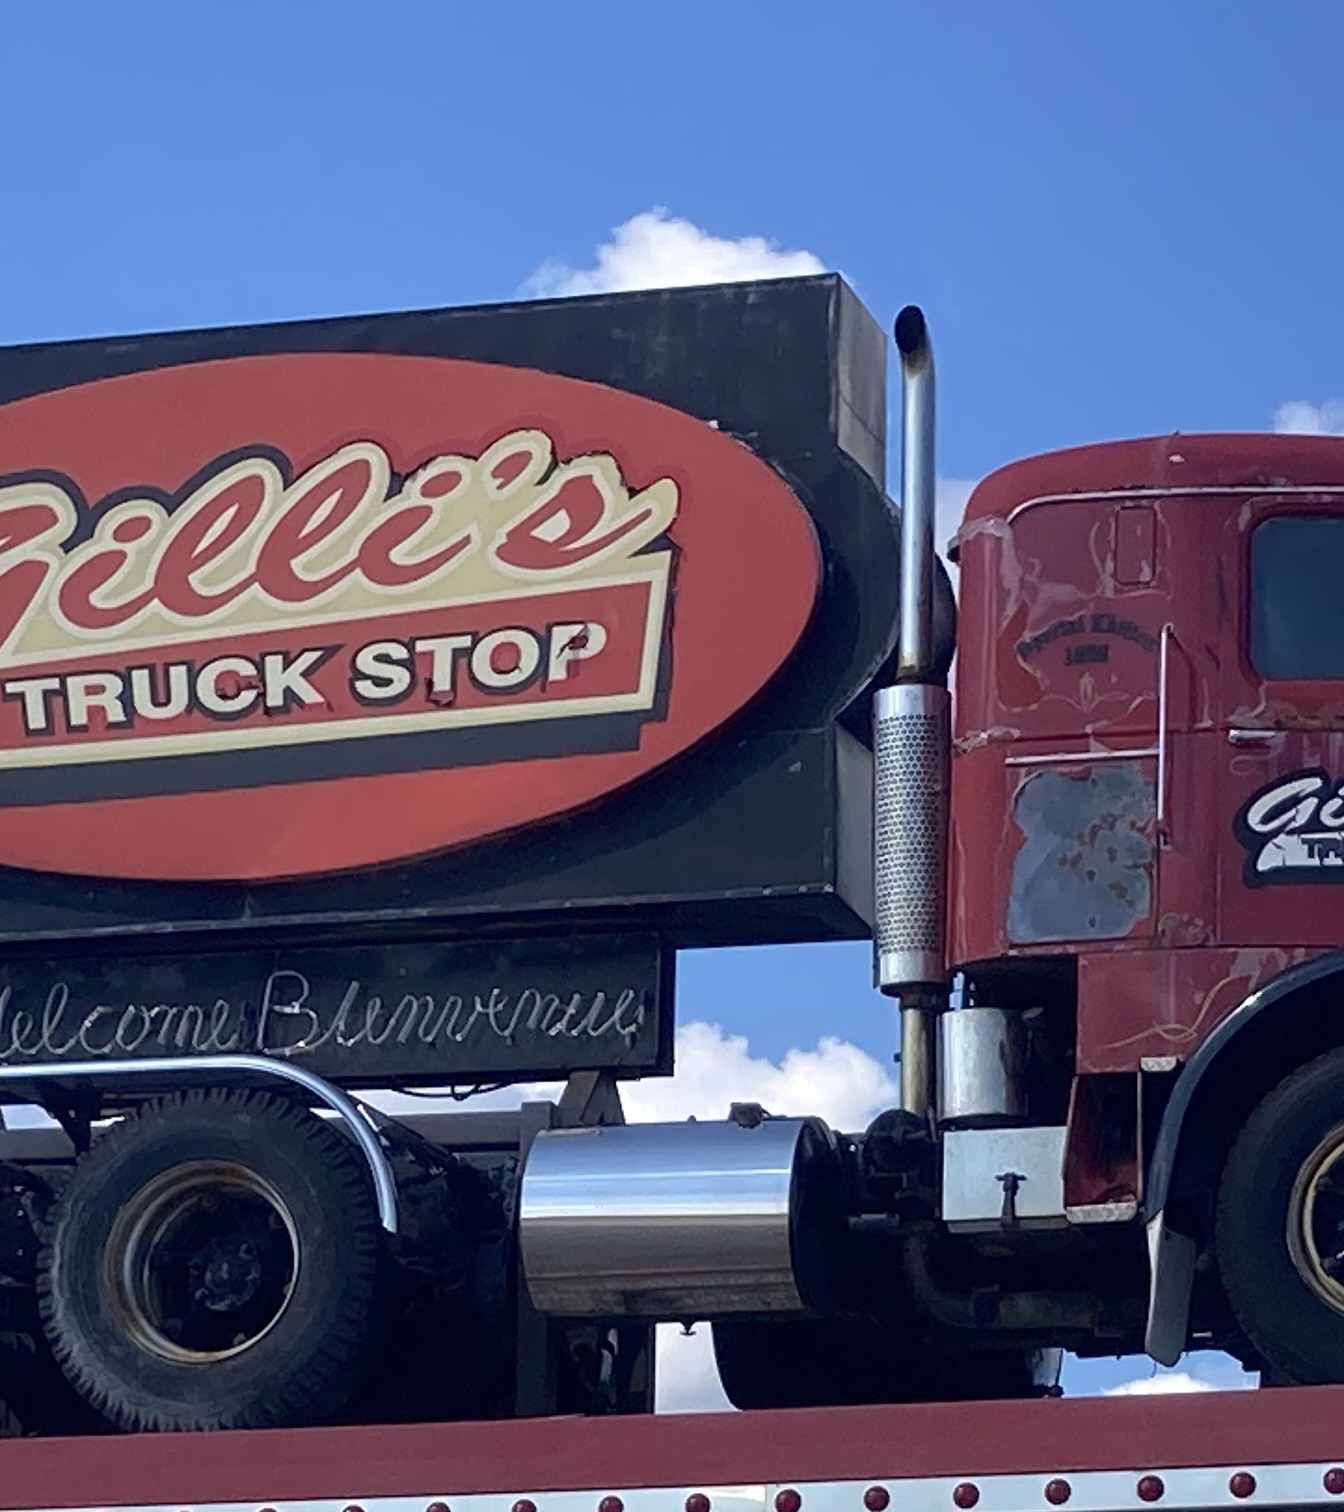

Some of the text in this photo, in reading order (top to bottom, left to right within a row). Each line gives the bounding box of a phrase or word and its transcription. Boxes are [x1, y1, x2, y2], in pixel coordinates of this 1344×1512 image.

[5, 621, 609, 731] TRUCK STOP
[258, 969, 647, 1056] Bienvenue
